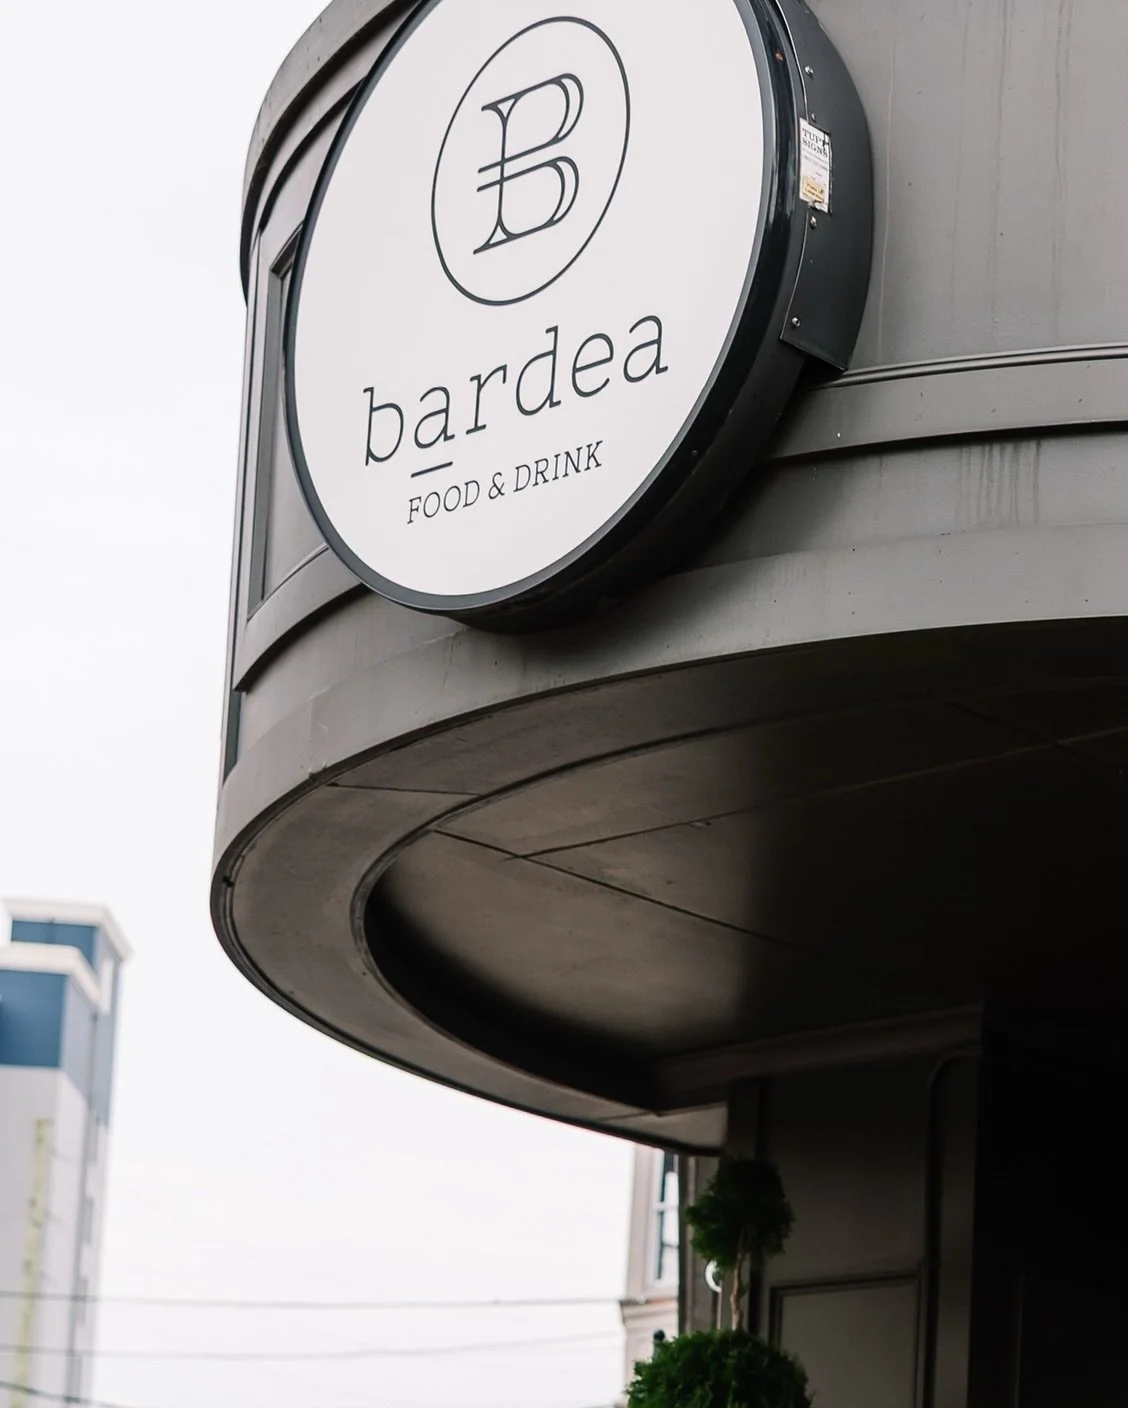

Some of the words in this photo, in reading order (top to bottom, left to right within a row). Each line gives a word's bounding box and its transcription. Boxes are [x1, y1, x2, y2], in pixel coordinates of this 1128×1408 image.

[362, 314, 669, 467] bardea
[406, 479, 481, 525] FOOD
[487, 471, 506, 500] &
[512, 439, 604, 493] DRINK
